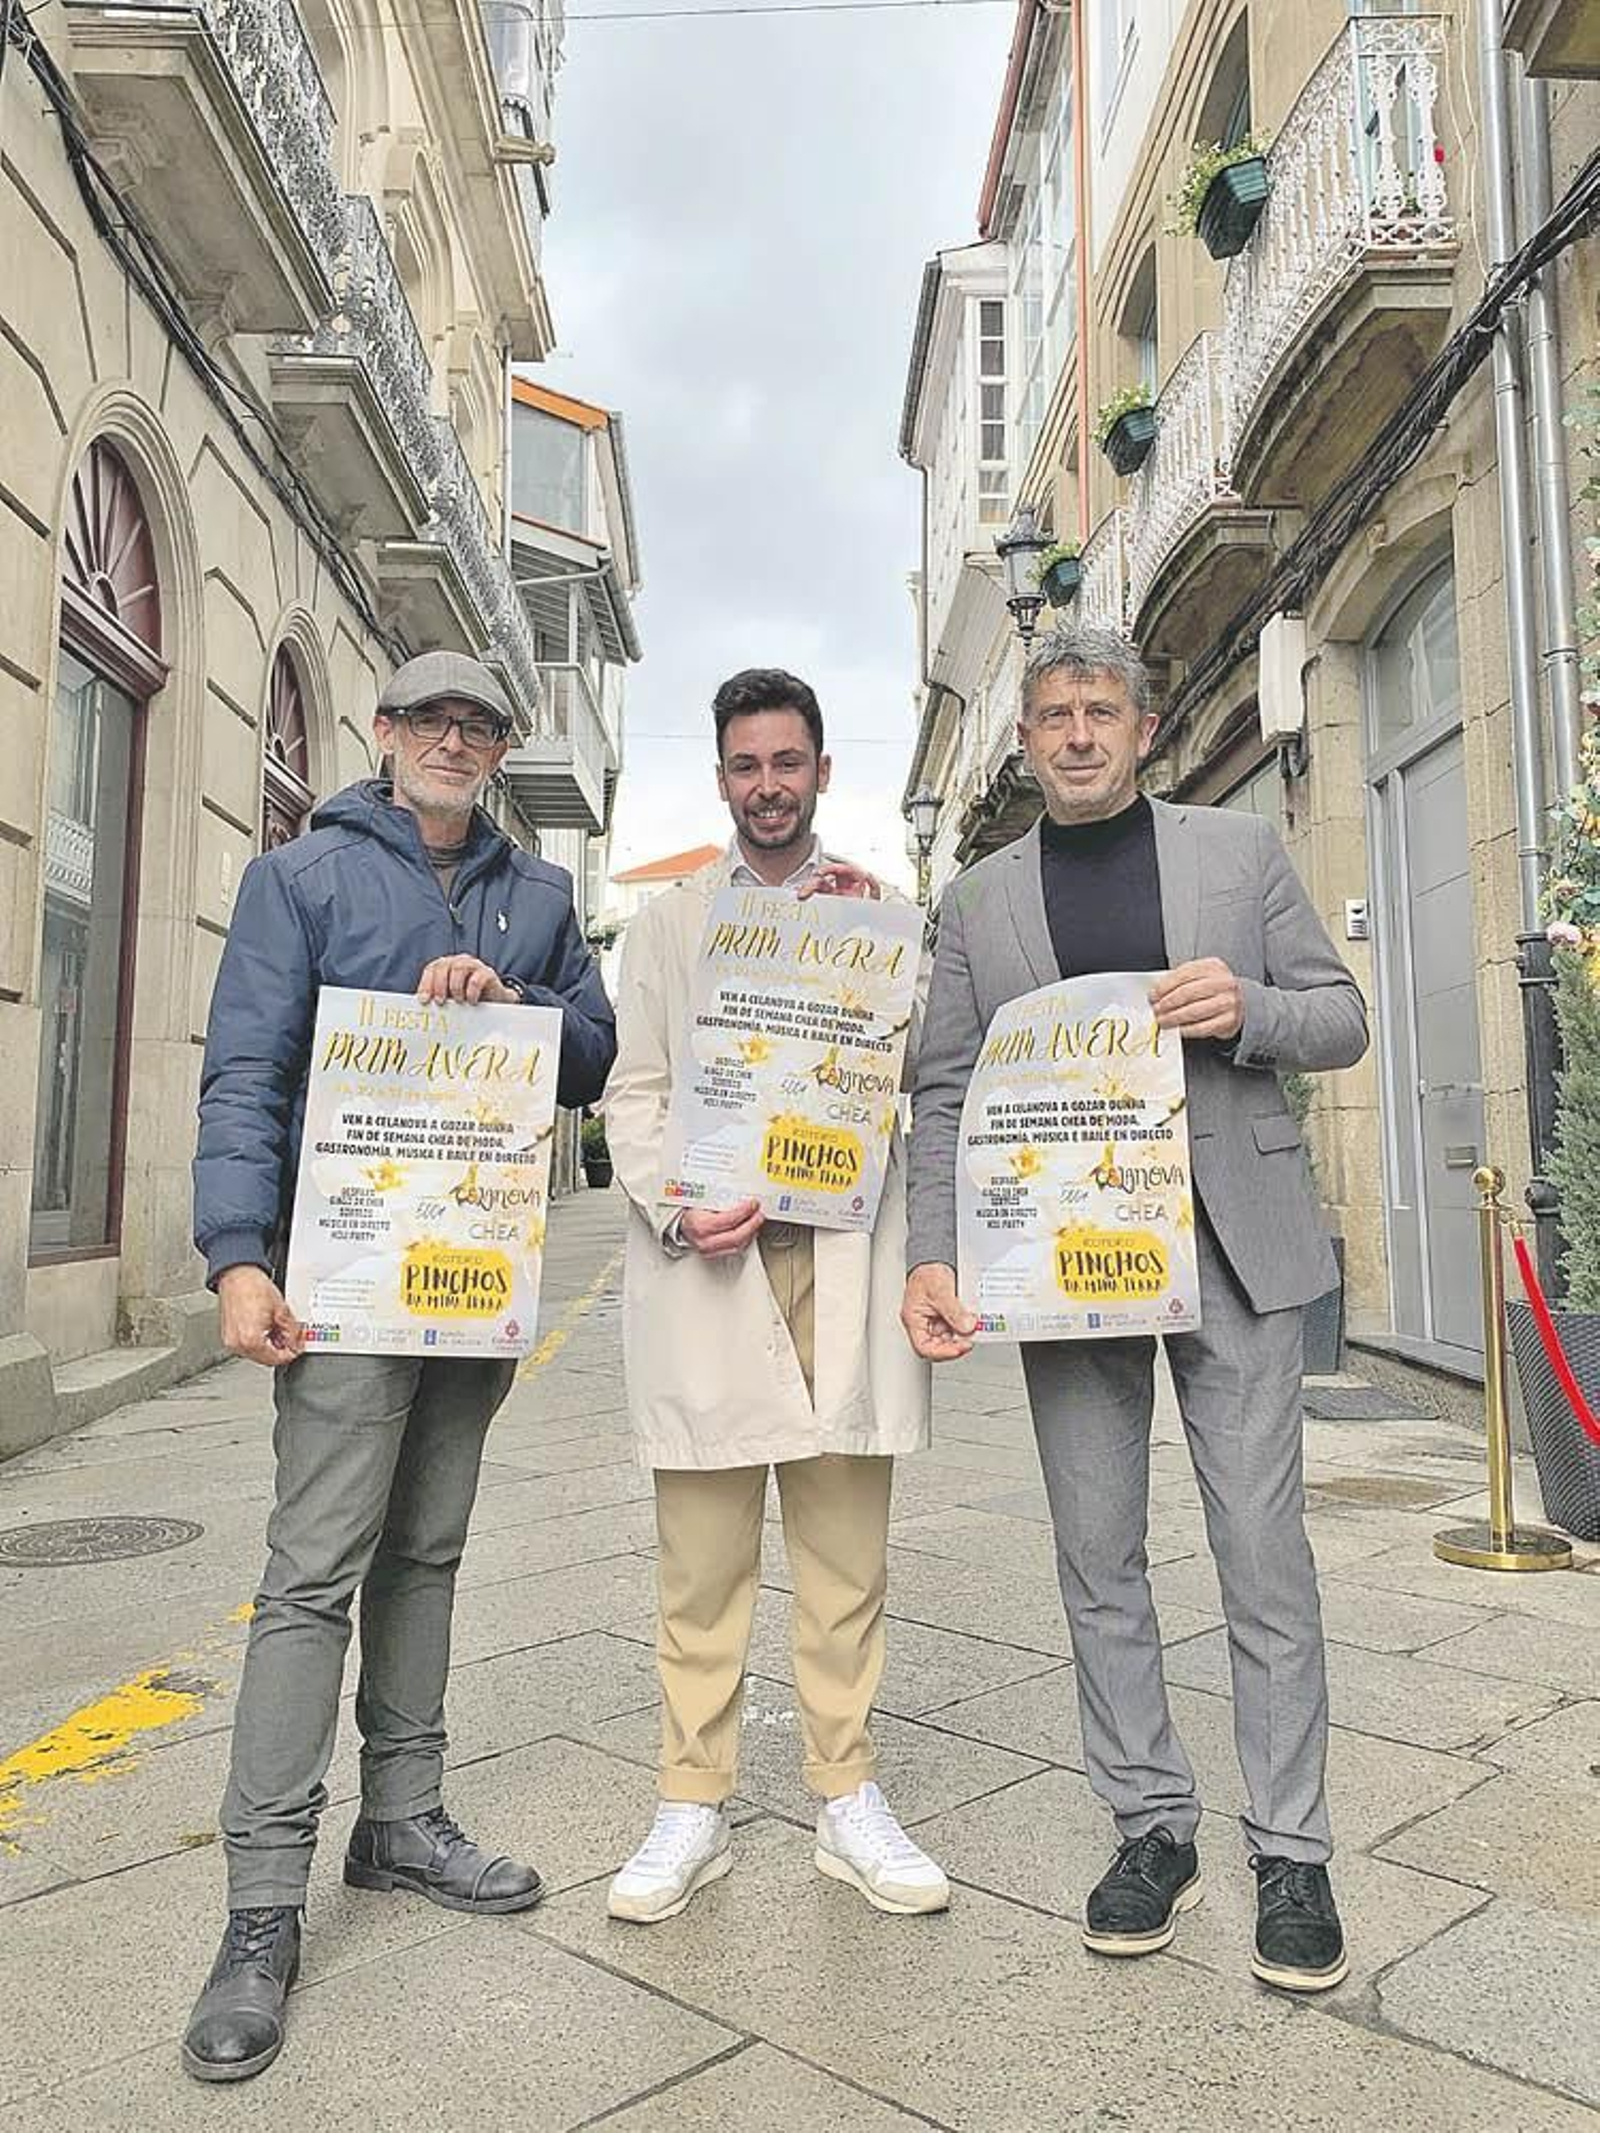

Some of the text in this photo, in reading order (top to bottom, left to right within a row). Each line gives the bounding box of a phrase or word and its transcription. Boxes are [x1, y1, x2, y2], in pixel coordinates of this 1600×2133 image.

[720, 991, 738, 1002] VEN
[740, 992, 747, 1003] A
[748, 994, 796, 1010] CELANOVA
[797, 1001, 804, 1011] A
[807, 1002, 839, 1015] GOZAR
[723, 1005, 738, 1015] FIN
[739, 1006, 751, 1018] DE
[754, 1009, 793, 1023] SEMANA
[795, 1014, 819, 1027] CHEA
[820, 1018, 834, 1030] DE
[802, 1029, 808, 1040] E
[810, 1030, 838, 1043] BAILE
[840, 1034, 853, 1046] EN
[855, 1037, 893, 1054] DIRECTO
[827, 1103, 872, 1125] CHEA
[986, 1104, 1002, 1115] VEN
[1004, 1103, 1011, 1114] A
[1012, 1101, 1058, 1114] CELANOVA
[1061, 1101, 1069, 1112] A
[1071, 1100, 1106, 1111] GOZAR
[342, 1114, 363, 1125] VEN
[365, 1115, 373, 1126] A
[375, 1116, 427, 1129] CELANOVA
[430, 1119, 438, 1129] A
[441, 1120, 476, 1131] GOZAR
[991, 1119, 1004, 1130] FIN
[1006, 1119, 1017, 1129] DE
[1019, 1117, 1059, 1128] SEMANA
[1061, 1116, 1087, 1127] CHEA
[1089, 1115, 1104, 1126] DE
[347, 1129, 364, 1141] FIN
[366, 1130, 380, 1142] DE
[383, 1131, 425, 1143] SEMANA
[428, 1133, 454, 1146] CHEA
[457, 1135, 472, 1147] DE
[1072, 1130, 1078, 1142] E
[1081, 1130, 1111, 1142] BAILE
[1113, 1129, 1127, 1141] EN
[1130, 1129, 1173, 1141] DIRECTO
[437, 1149, 444, 1160] E
[447, 1150, 474, 1161] BAILE
[478, 1150, 493, 1162] EN
[495, 1152, 536, 1165] DIRECTO
[767, 1135, 858, 1172] PINCHOS
[1115, 1204, 1168, 1222] CHEA
[469, 1223, 519, 1241] CHEA
[1059, 1249, 1164, 1278] PINCHOS
[406, 1264, 508, 1294] PINCHOS
